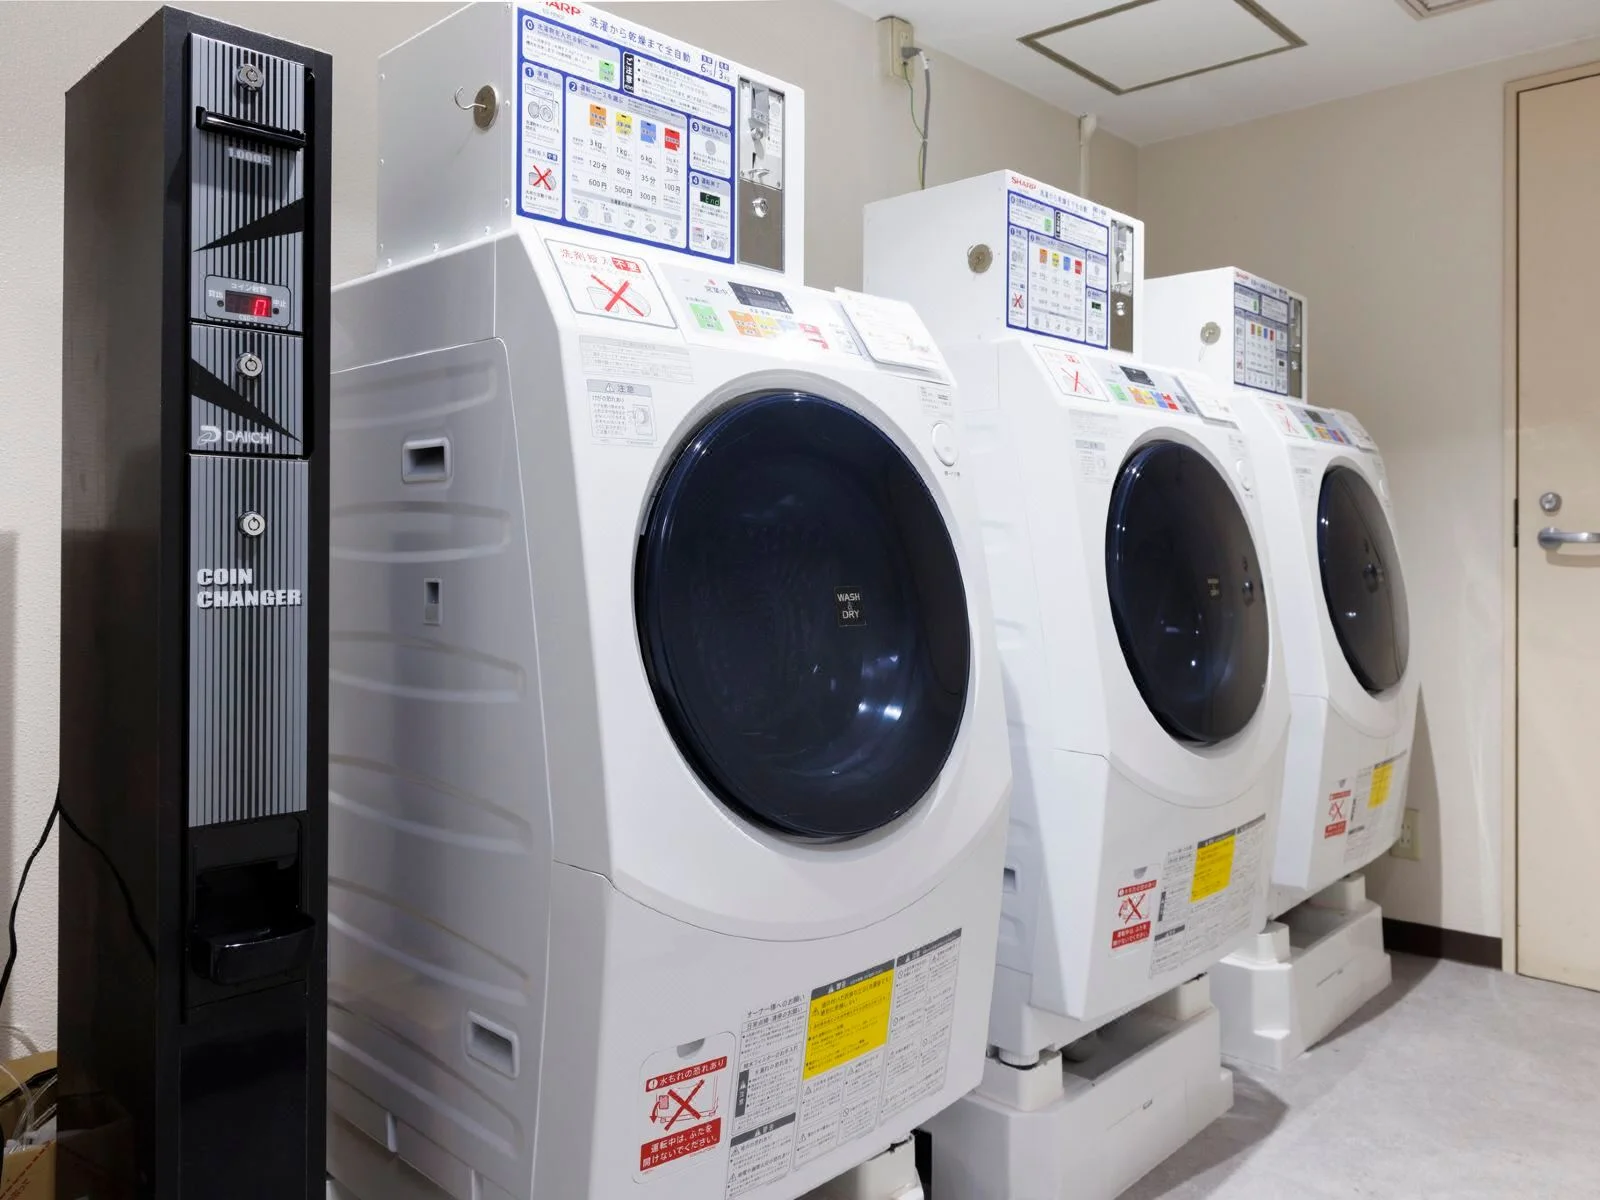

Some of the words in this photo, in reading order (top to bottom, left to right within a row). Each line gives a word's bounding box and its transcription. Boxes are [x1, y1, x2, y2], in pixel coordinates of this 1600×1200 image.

[589, 16, 691, 63] 洗濯から乾燥まで全自動
[588, 178, 607, 190] 600円
[615, 185, 633, 197] 500円
[664, 183, 681, 194] 100円
[705, 194, 720, 207] End
[225, 430, 273, 445] DAIICHI
[197, 568, 253, 586] COIN
[197, 589, 302, 608] CHANGER
[837, 593, 860, 602] WASH
[842, 610, 860, 619] DRY
[660, 1059, 725, 1086] 水もれの恐れあり
[650, 1125, 713, 1153] 運転中は、ふたを
